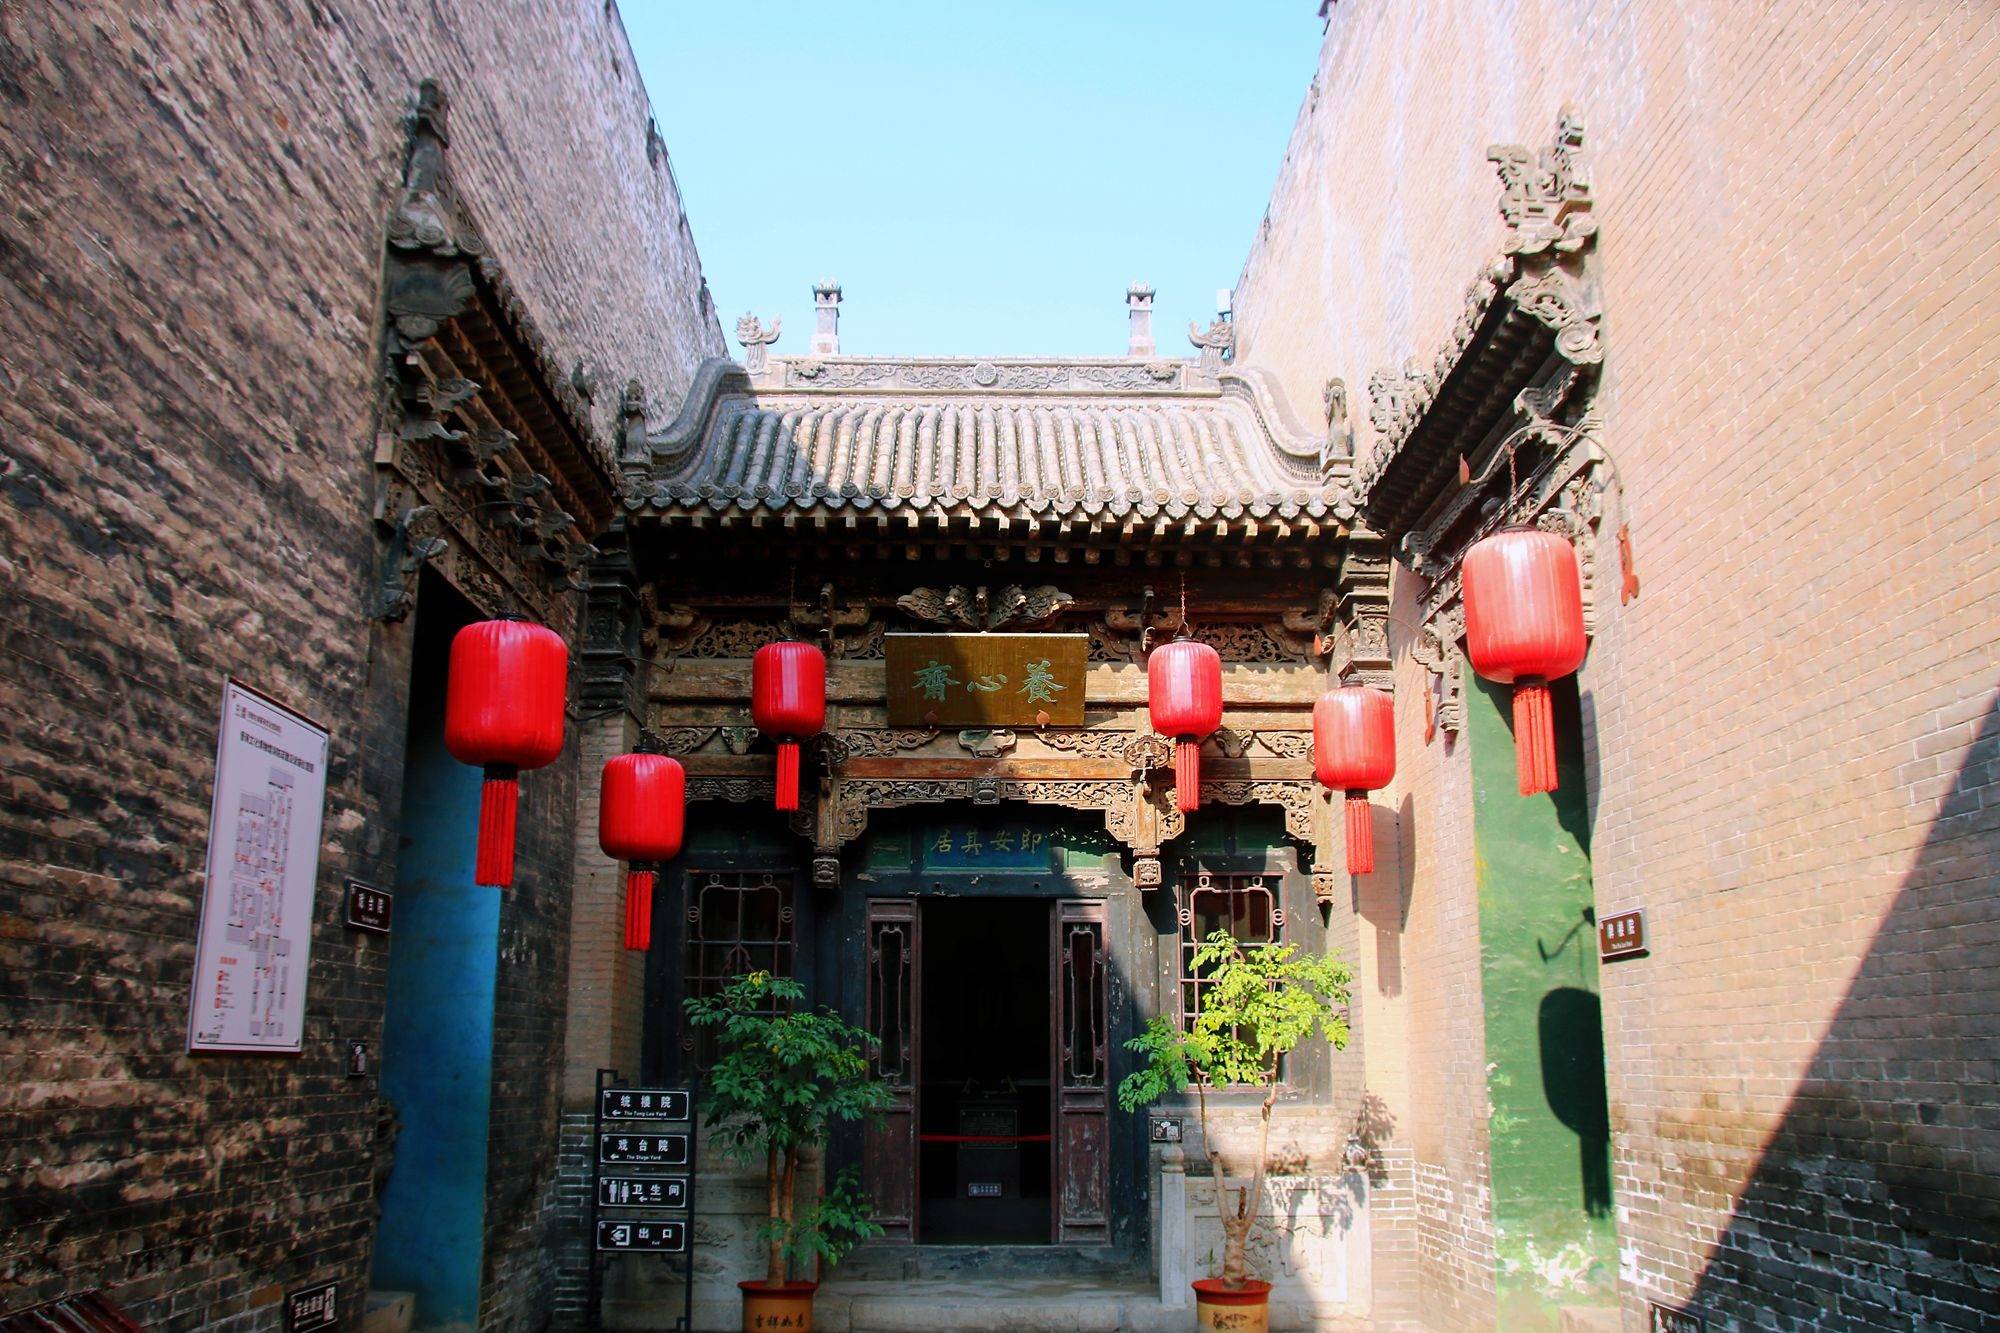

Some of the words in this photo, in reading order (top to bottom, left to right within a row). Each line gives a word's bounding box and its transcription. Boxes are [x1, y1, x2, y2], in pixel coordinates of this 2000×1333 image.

[618, 1139, 669, 1152] 戏台院
[632, 1184, 680, 1196] 卫生间
[638, 1227, 672, 1239] 出口
